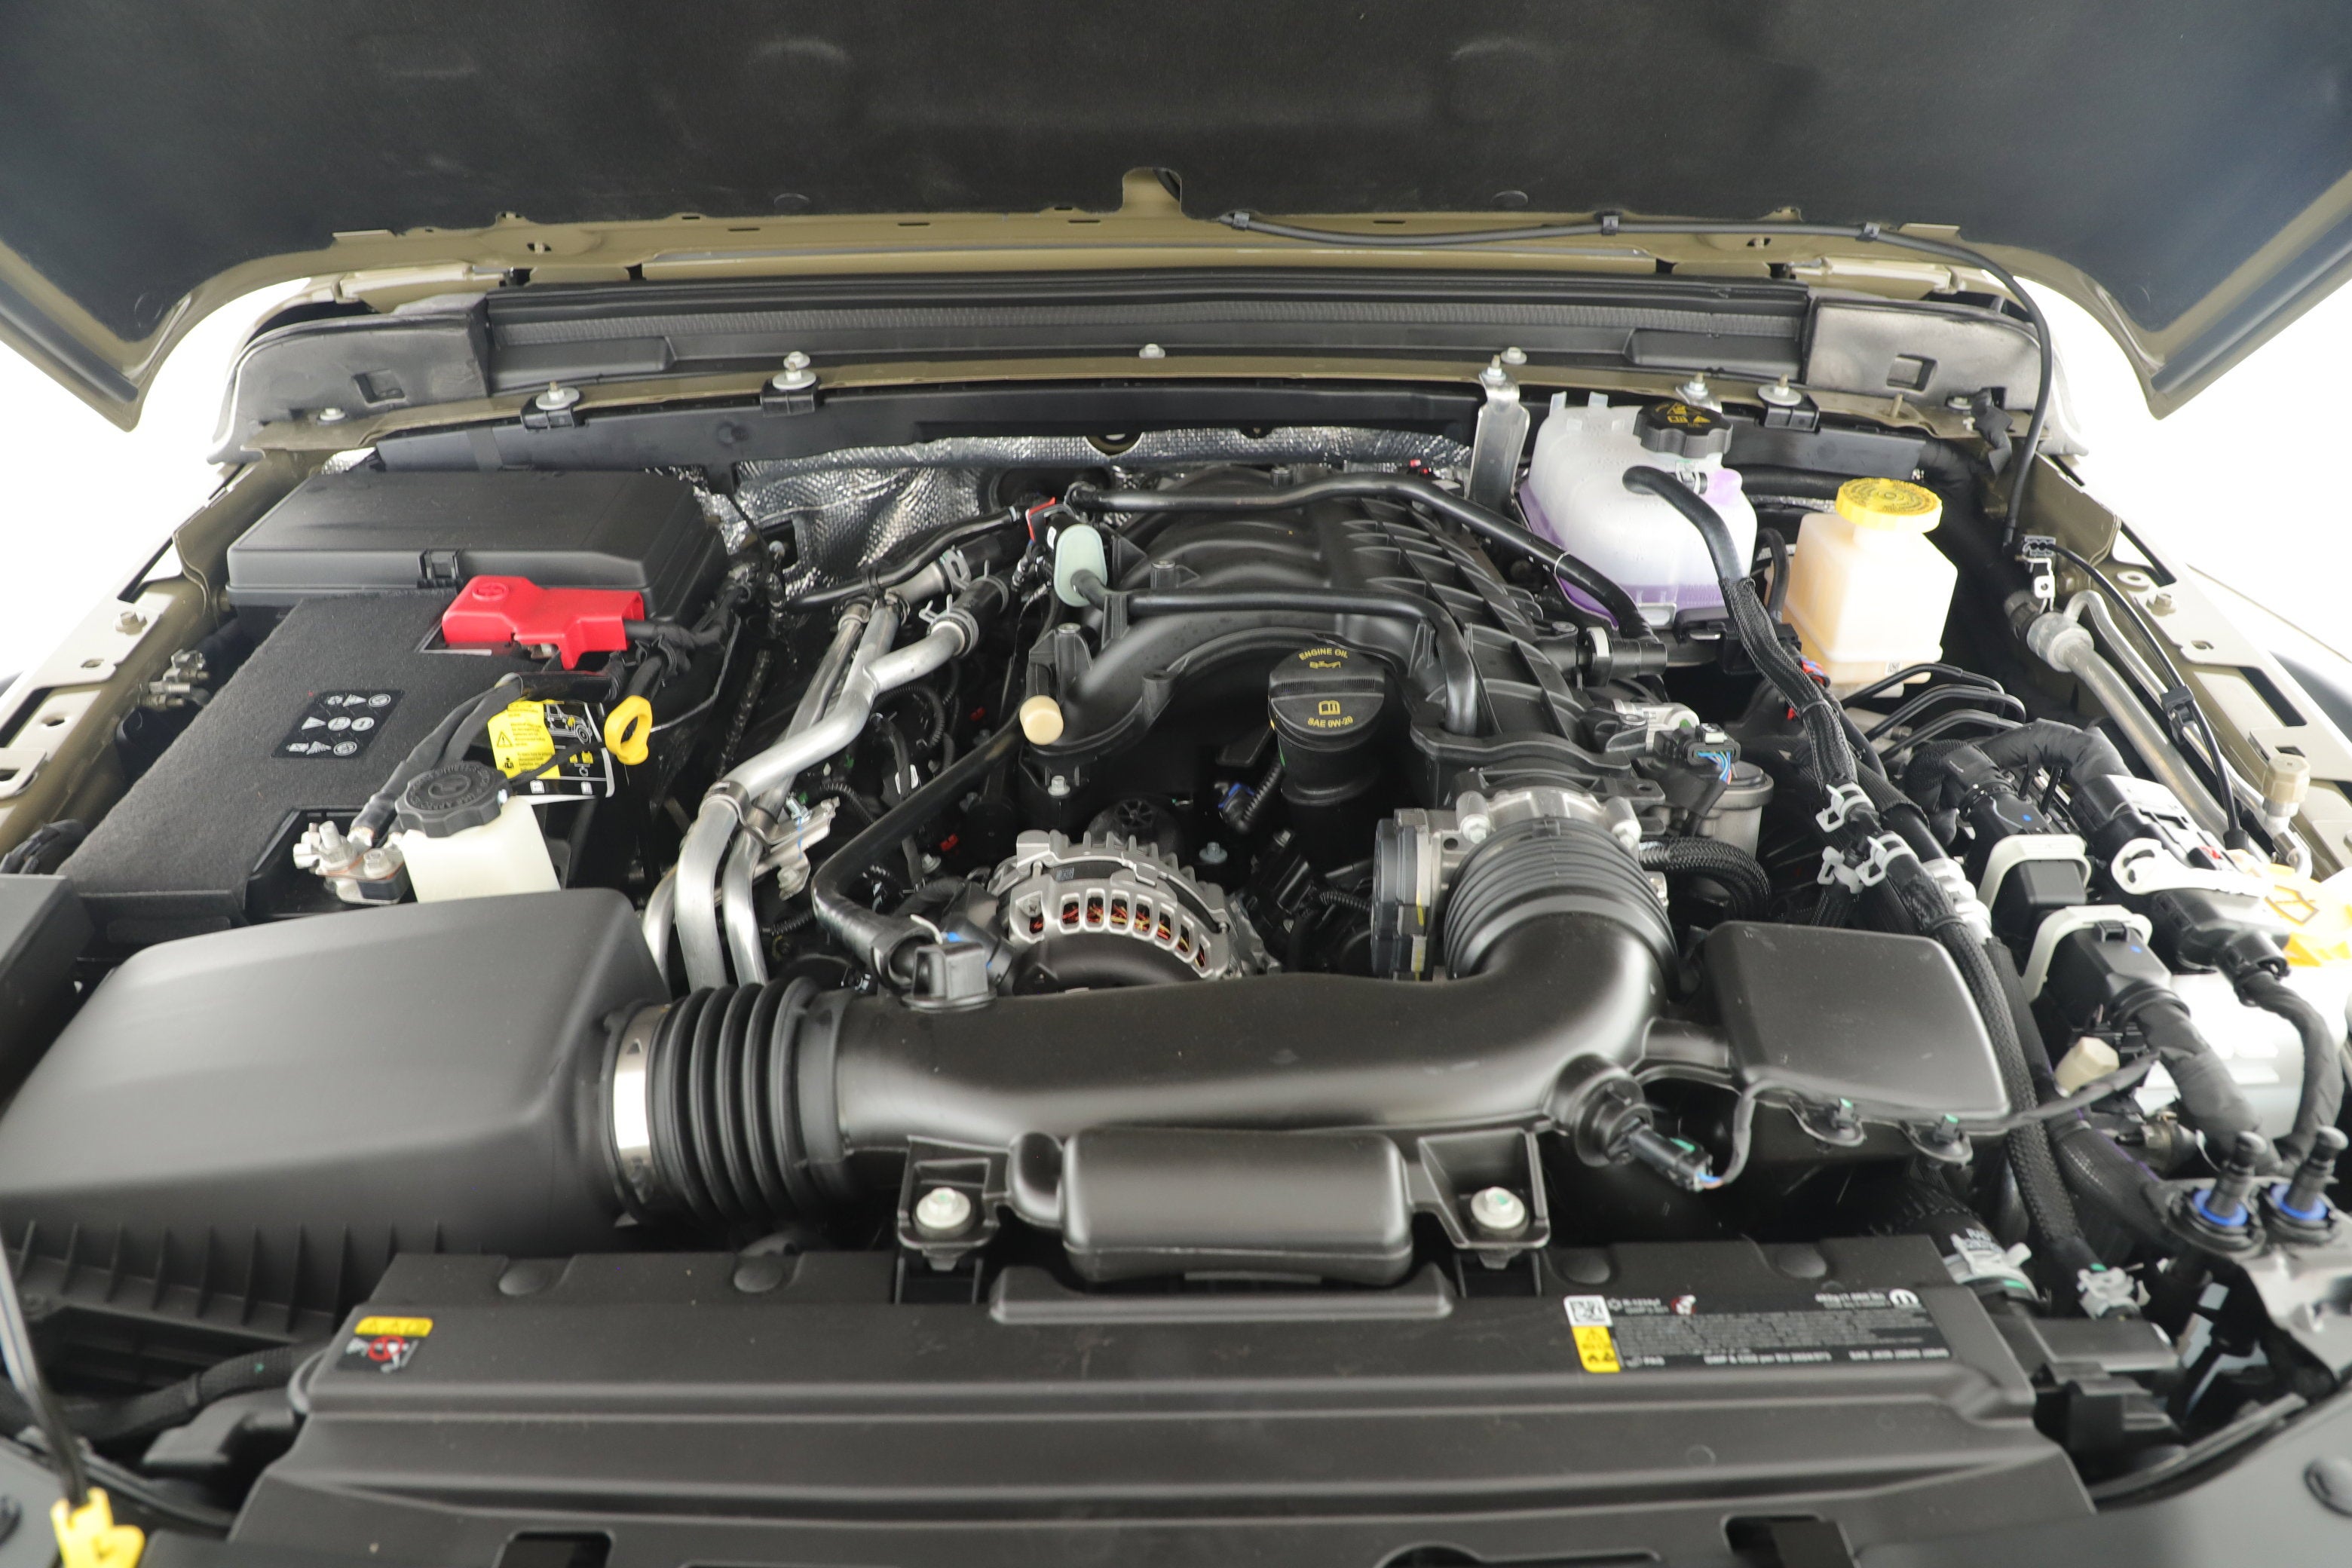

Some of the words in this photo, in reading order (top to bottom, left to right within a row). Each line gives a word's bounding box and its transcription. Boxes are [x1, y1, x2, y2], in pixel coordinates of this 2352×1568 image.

[1298, 648, 1333, 660] ENGINE
[1334, 648, 1349, 659] OIL
[1307, 717, 1326, 728] SAE
[1328, 715, 1354, 728] 0W-20
